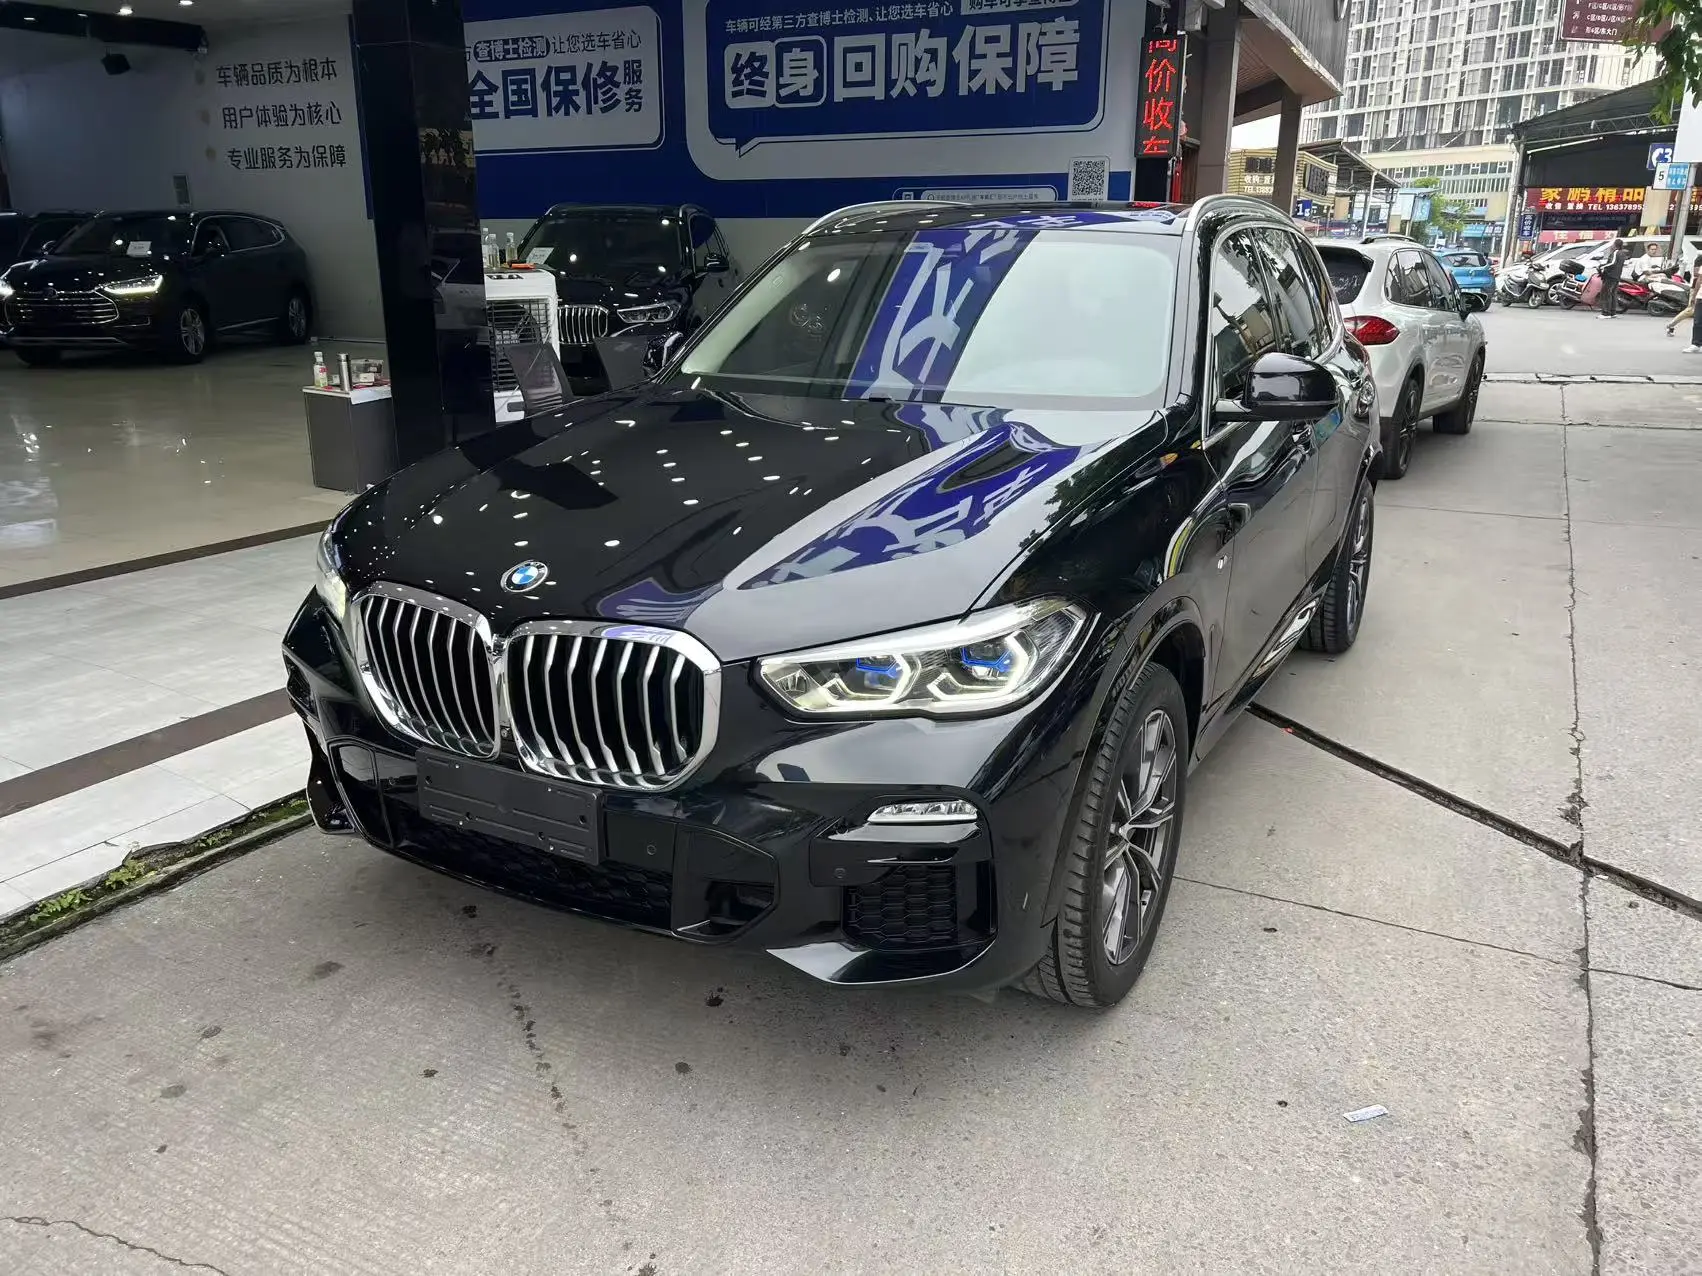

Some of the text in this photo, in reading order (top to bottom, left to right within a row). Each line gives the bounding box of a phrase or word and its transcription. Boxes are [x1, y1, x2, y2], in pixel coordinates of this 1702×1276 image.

[216, 57, 338, 87] 车辆品质为根本
[470, 61, 622, 119] 全国保修
[222, 101, 342, 130] 用户体验为核心
[227, 144, 347, 170] 专业服务为保障
[1588, 203, 1603, 211] TEL
